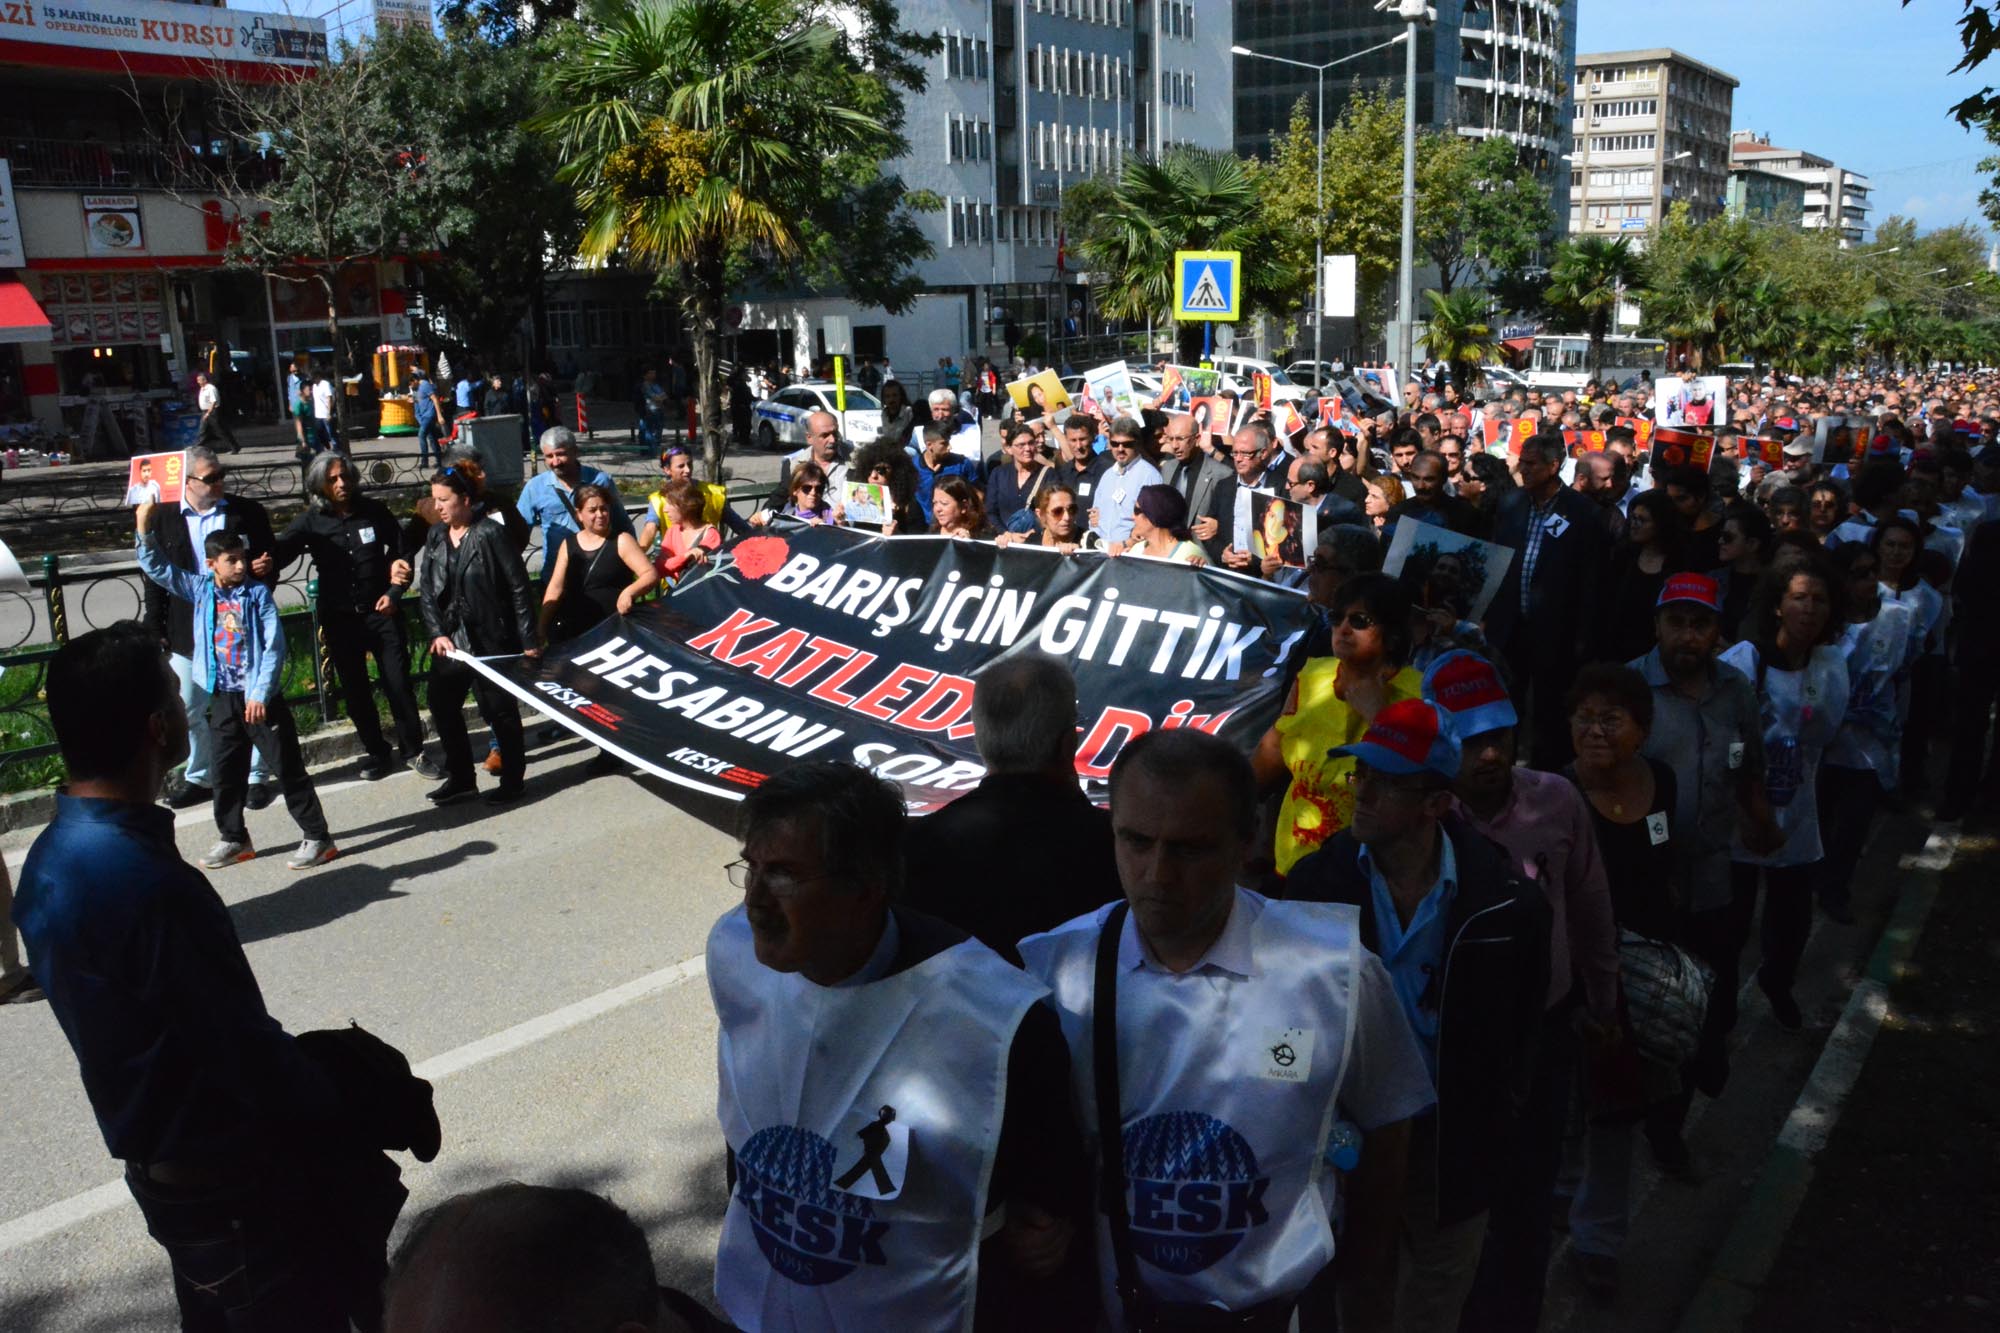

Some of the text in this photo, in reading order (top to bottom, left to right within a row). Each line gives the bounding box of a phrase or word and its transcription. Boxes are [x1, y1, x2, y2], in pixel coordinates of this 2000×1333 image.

[0, 0, 36, 27] Zİ
[141, 18, 234, 48] KURSU
[764, 553, 924, 637] BARIŞ
[919, 570, 1037, 652] İÇİN
[1039, 587, 1267, 680] GİTTİK
[570, 636, 845, 758] HESABINI
[666, 747, 737, 776] KESK
